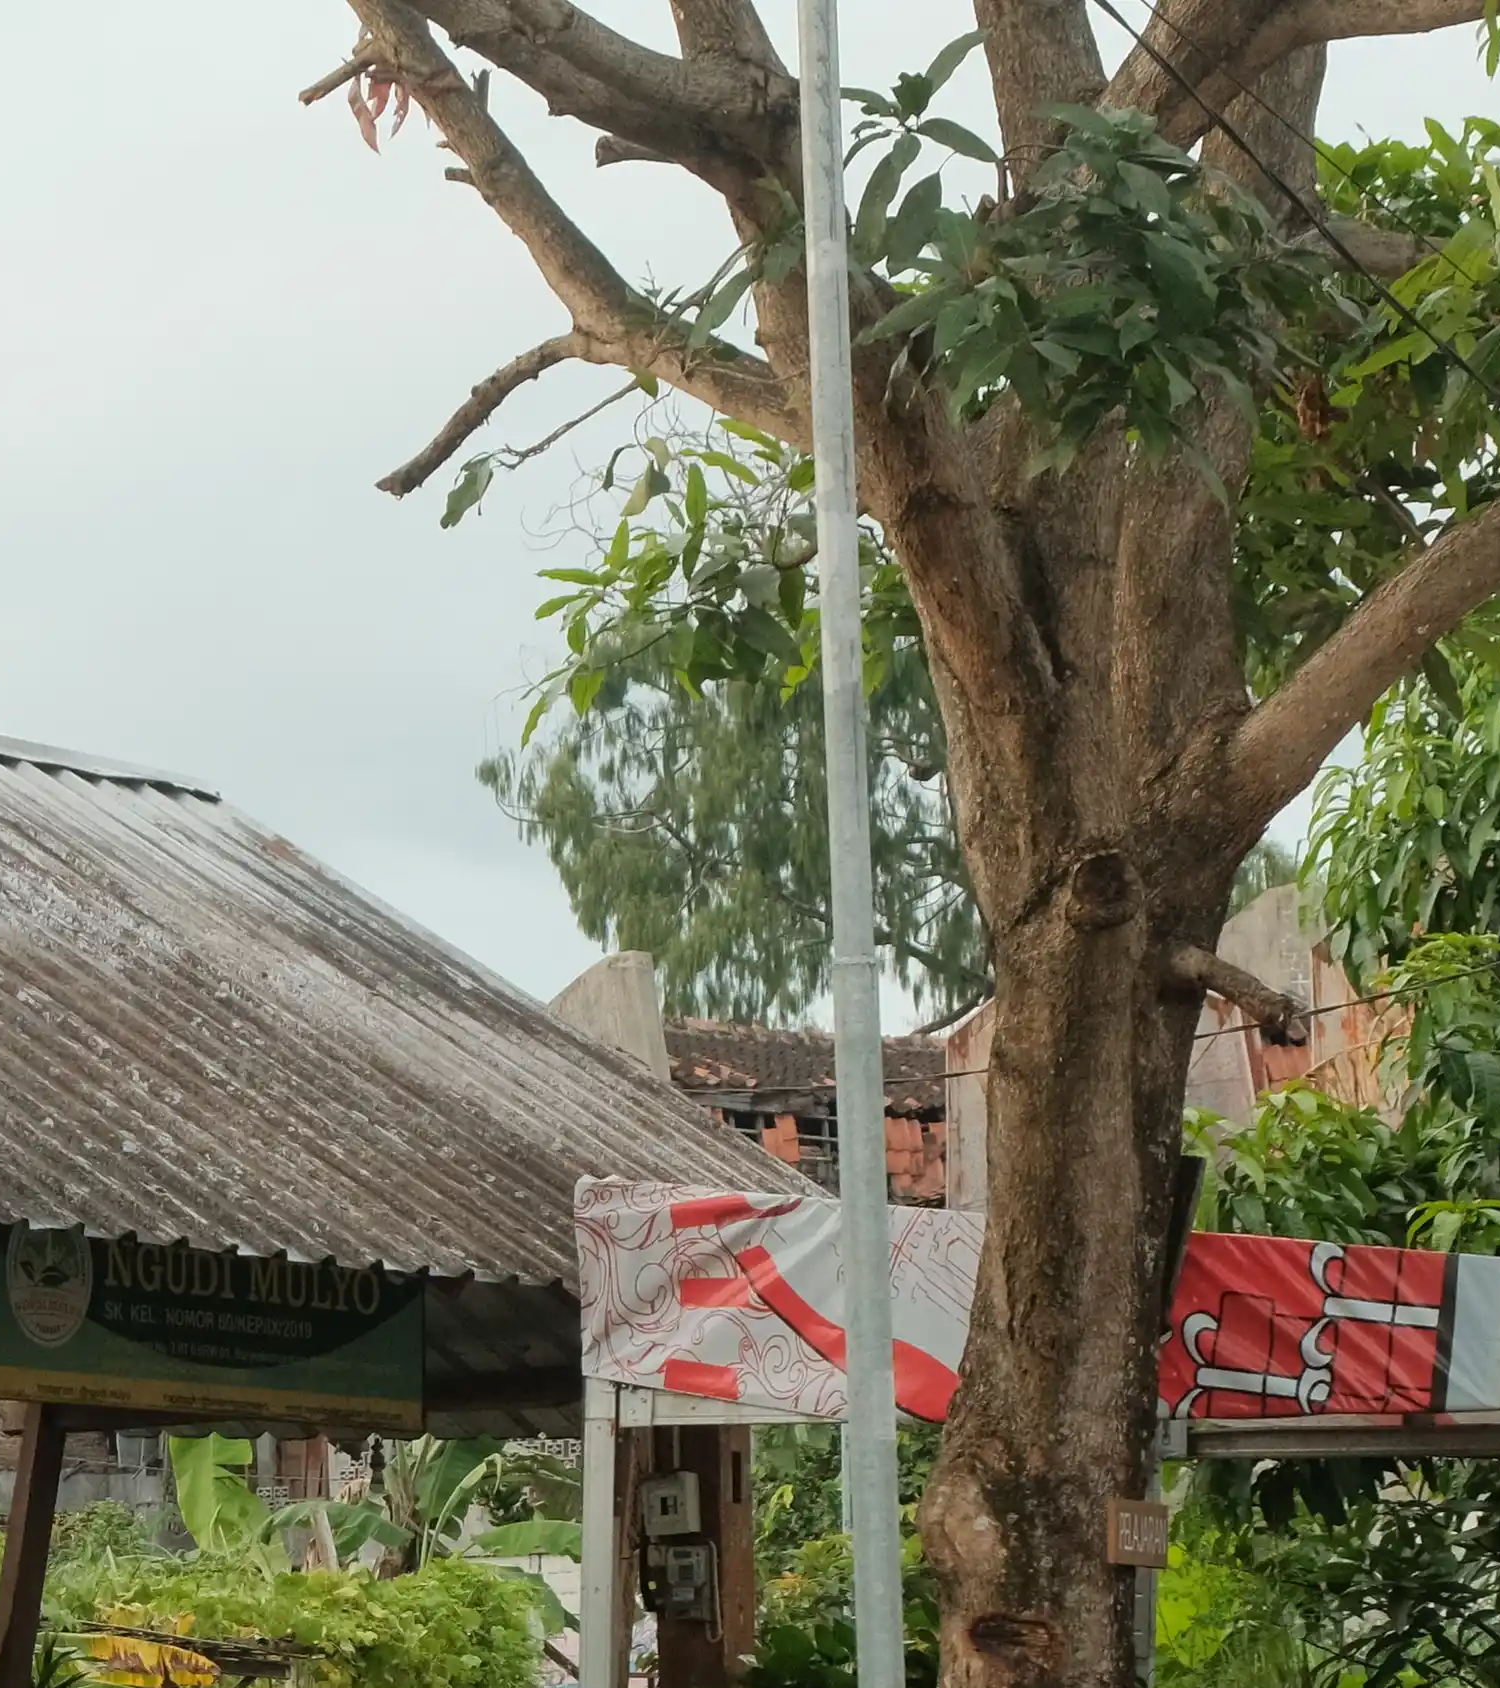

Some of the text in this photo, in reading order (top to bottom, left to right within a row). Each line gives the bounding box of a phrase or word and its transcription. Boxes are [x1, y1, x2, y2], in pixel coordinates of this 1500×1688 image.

[103, 1242, 381, 1315] NGUDI MULYO
[101, 1299, 124, 1321] SK
